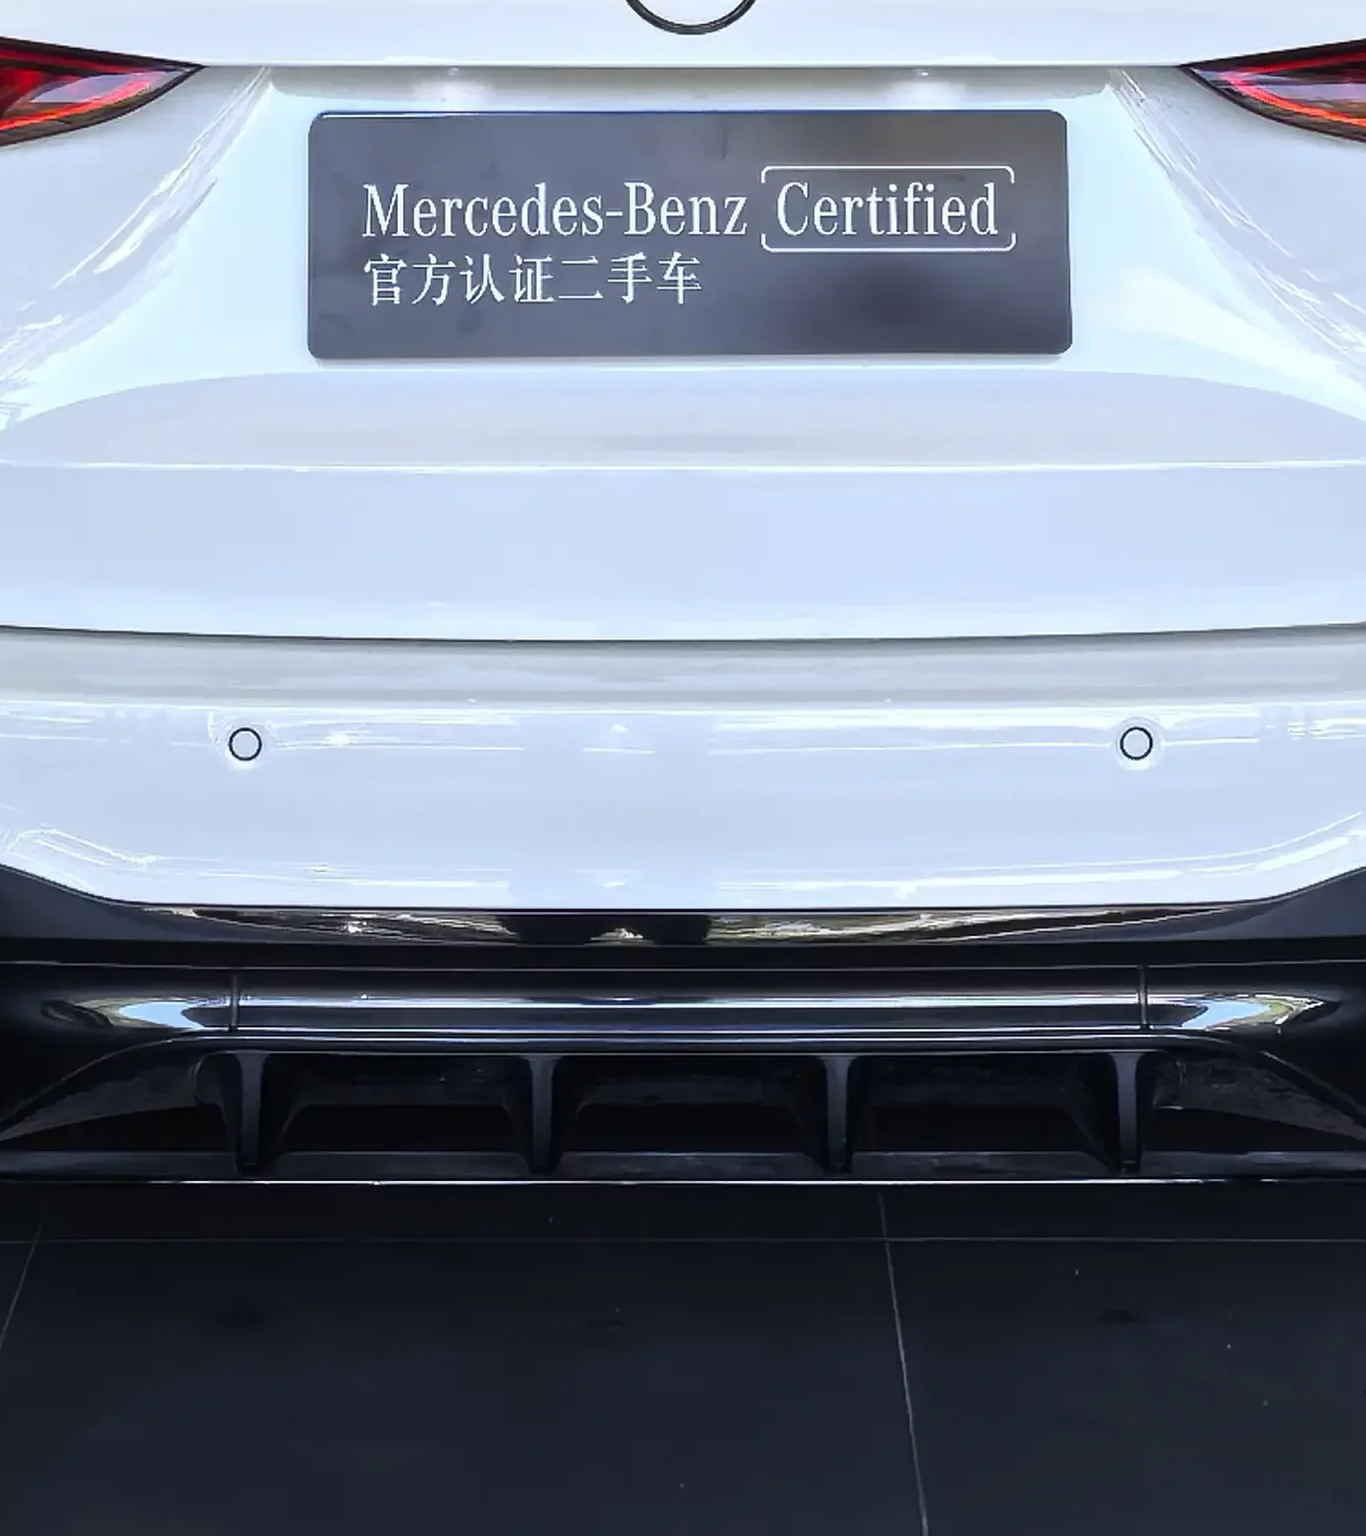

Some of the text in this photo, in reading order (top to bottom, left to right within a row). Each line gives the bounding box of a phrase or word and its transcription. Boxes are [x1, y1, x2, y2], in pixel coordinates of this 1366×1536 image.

[362, 181, 999, 238] Mercedes-Benz Certified
[363, 251, 703, 306] 官方认证二手车
